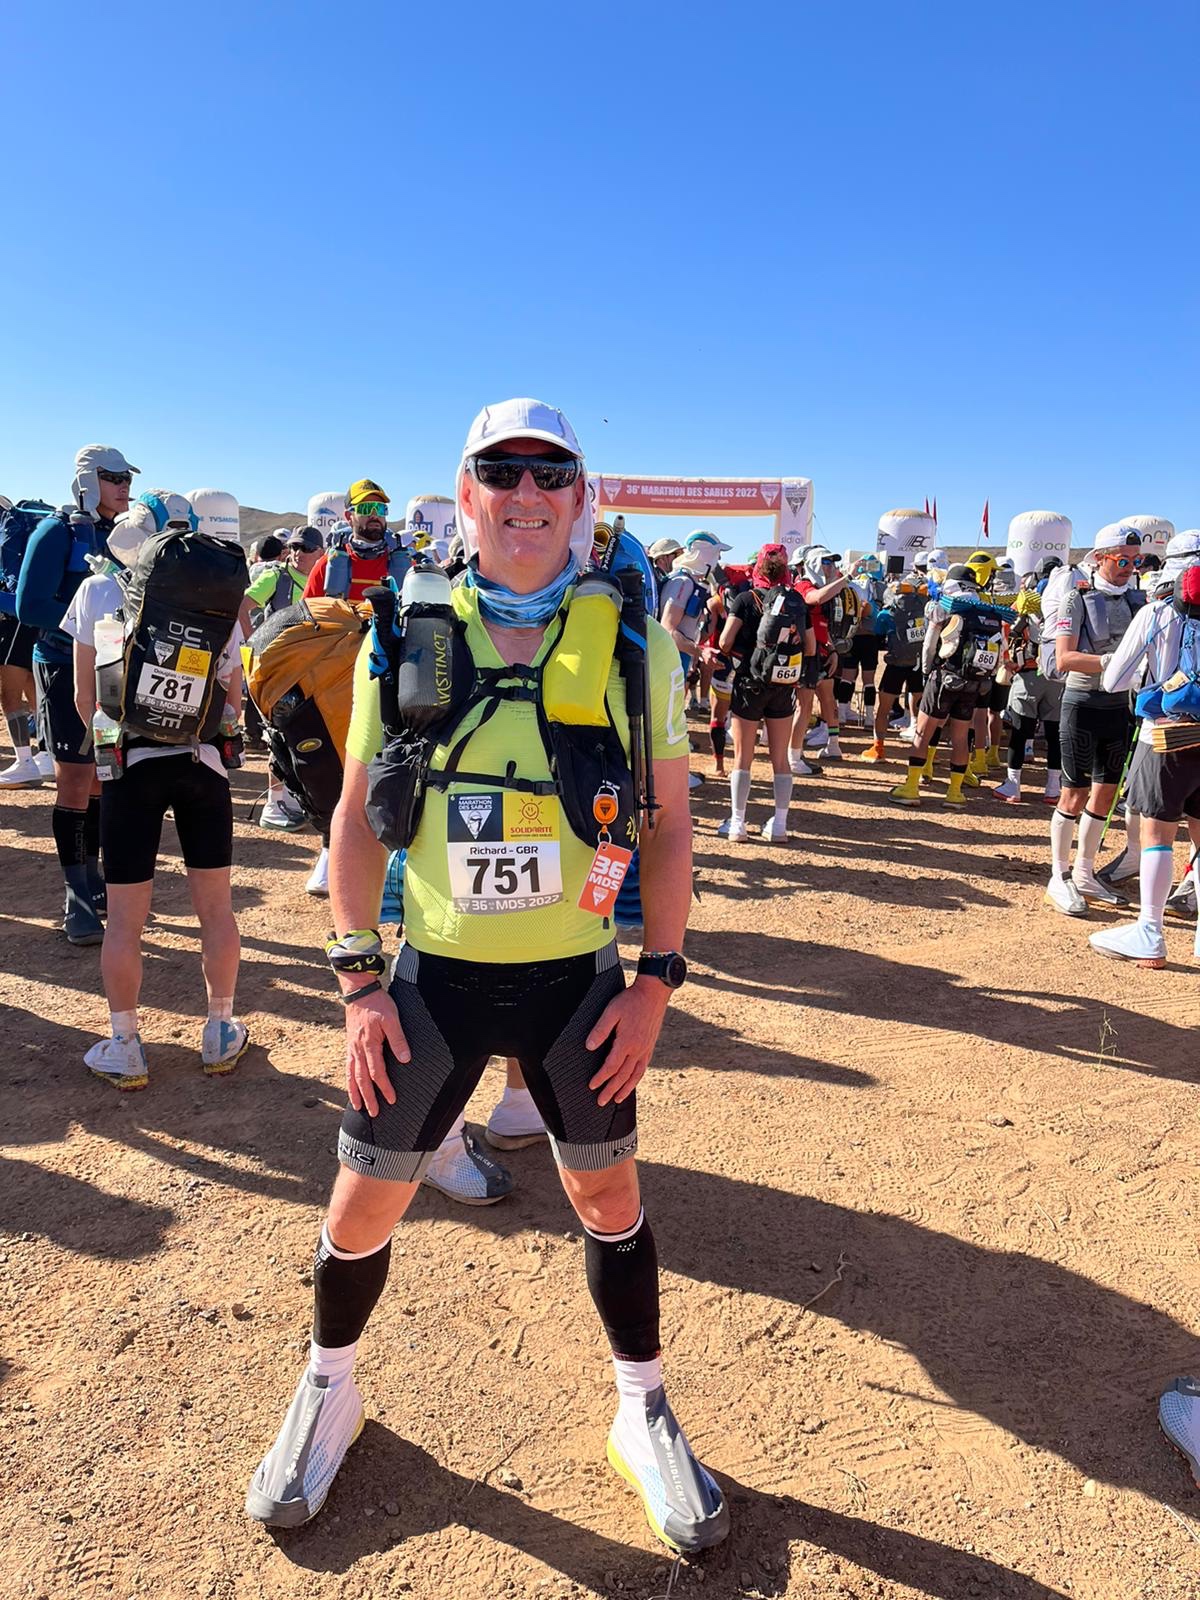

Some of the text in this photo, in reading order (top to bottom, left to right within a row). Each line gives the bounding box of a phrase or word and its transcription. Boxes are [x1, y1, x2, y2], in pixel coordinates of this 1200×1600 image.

[641, 486, 685, 497] MARATHON
[687, 487, 702, 496] DES
[704, 487, 733, 497] SABLES
[735, 488, 758, 497] 2022
[408, 524, 431, 534] DARI
[1044, 542, 1067, 551] OCP
[977, 653, 994, 665] 860
[776, 669, 797, 679] 664
[149, 674, 193, 703] 781
[160, 700, 178, 711] MDS
[178, 705, 197, 714] 2022
[469, 846, 507, 855] Richard
[516, 846, 539, 855] GBR
[592, 855, 626, 881] 36
[466, 857, 541, 895] 751
[588, 873, 620, 891] MDS
[496, 897, 526, 911] MDS
[528, 894, 560, 905] 2022
[292, 1407, 315, 1460] RAIDLIGHT
[665, 1451, 687, 1503] RAIDLIGHT
